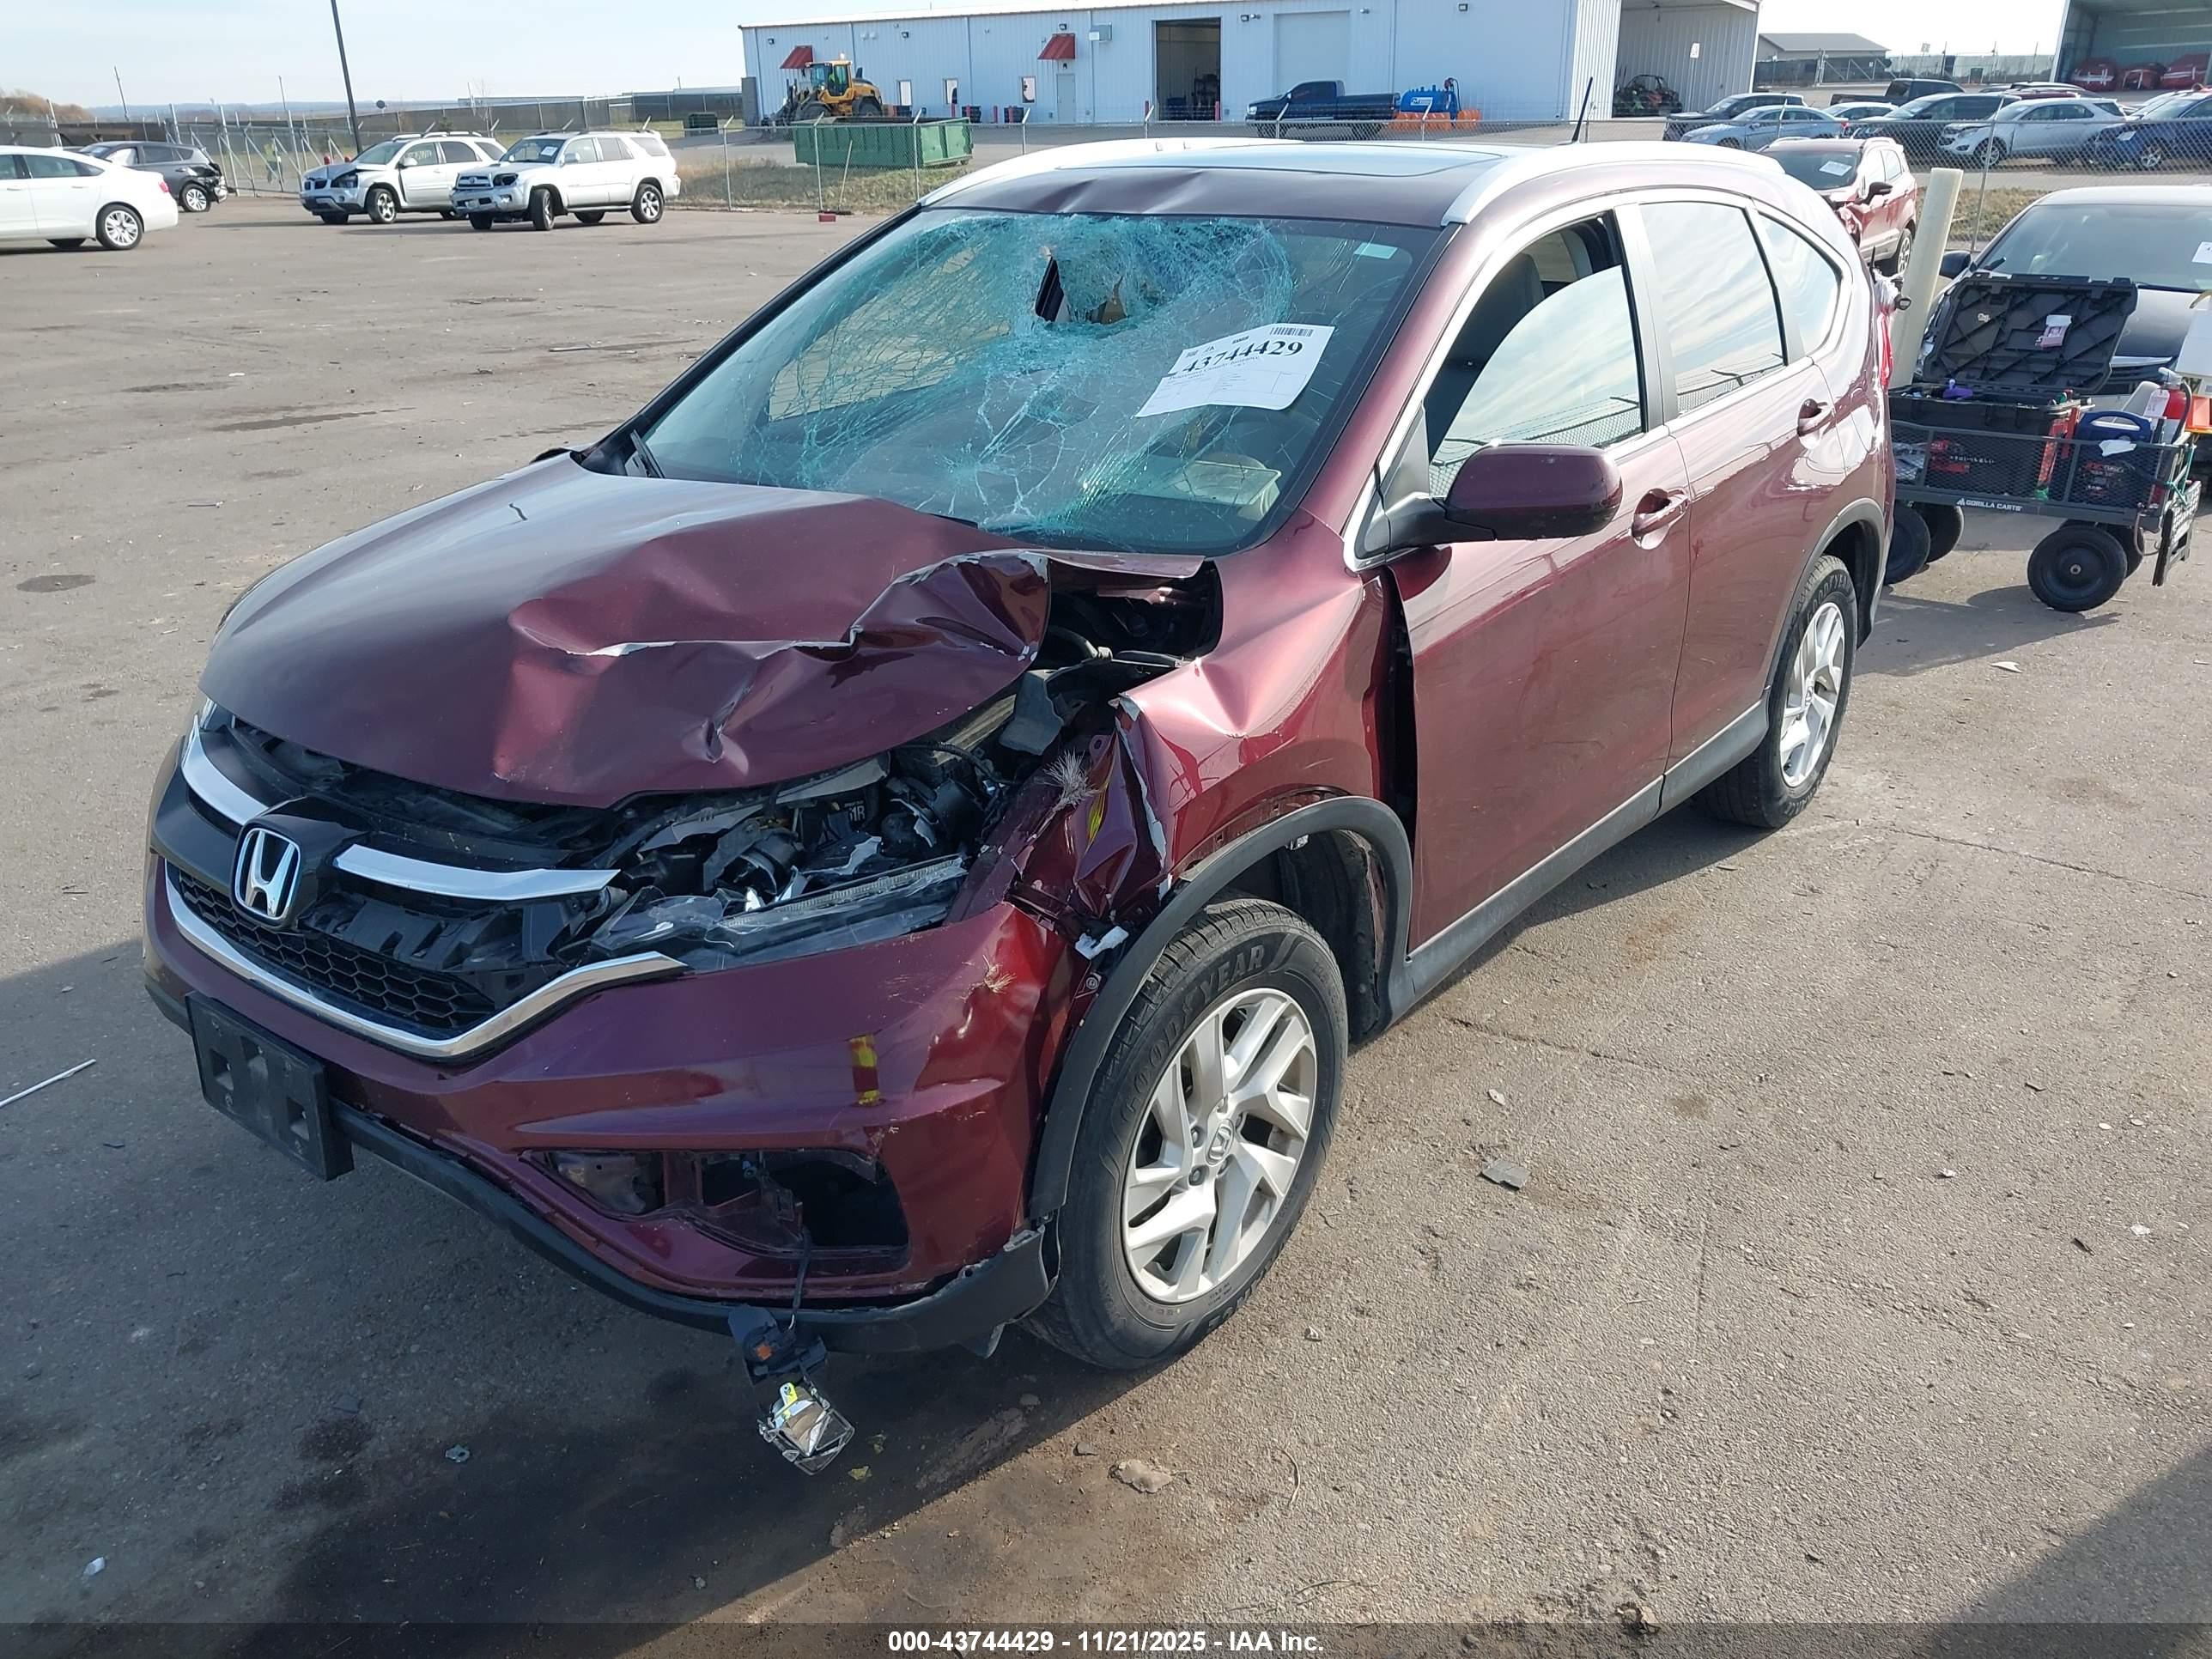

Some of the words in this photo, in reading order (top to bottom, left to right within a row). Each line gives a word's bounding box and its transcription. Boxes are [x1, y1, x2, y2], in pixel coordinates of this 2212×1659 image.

[1182, 340, 1304, 373] 43744429
[1966, 499, 1995, 508] GORILLA
[1996, 503, 2021, 512] CARTS
[1120, 944, 1267, 1123] GOODYEAR
